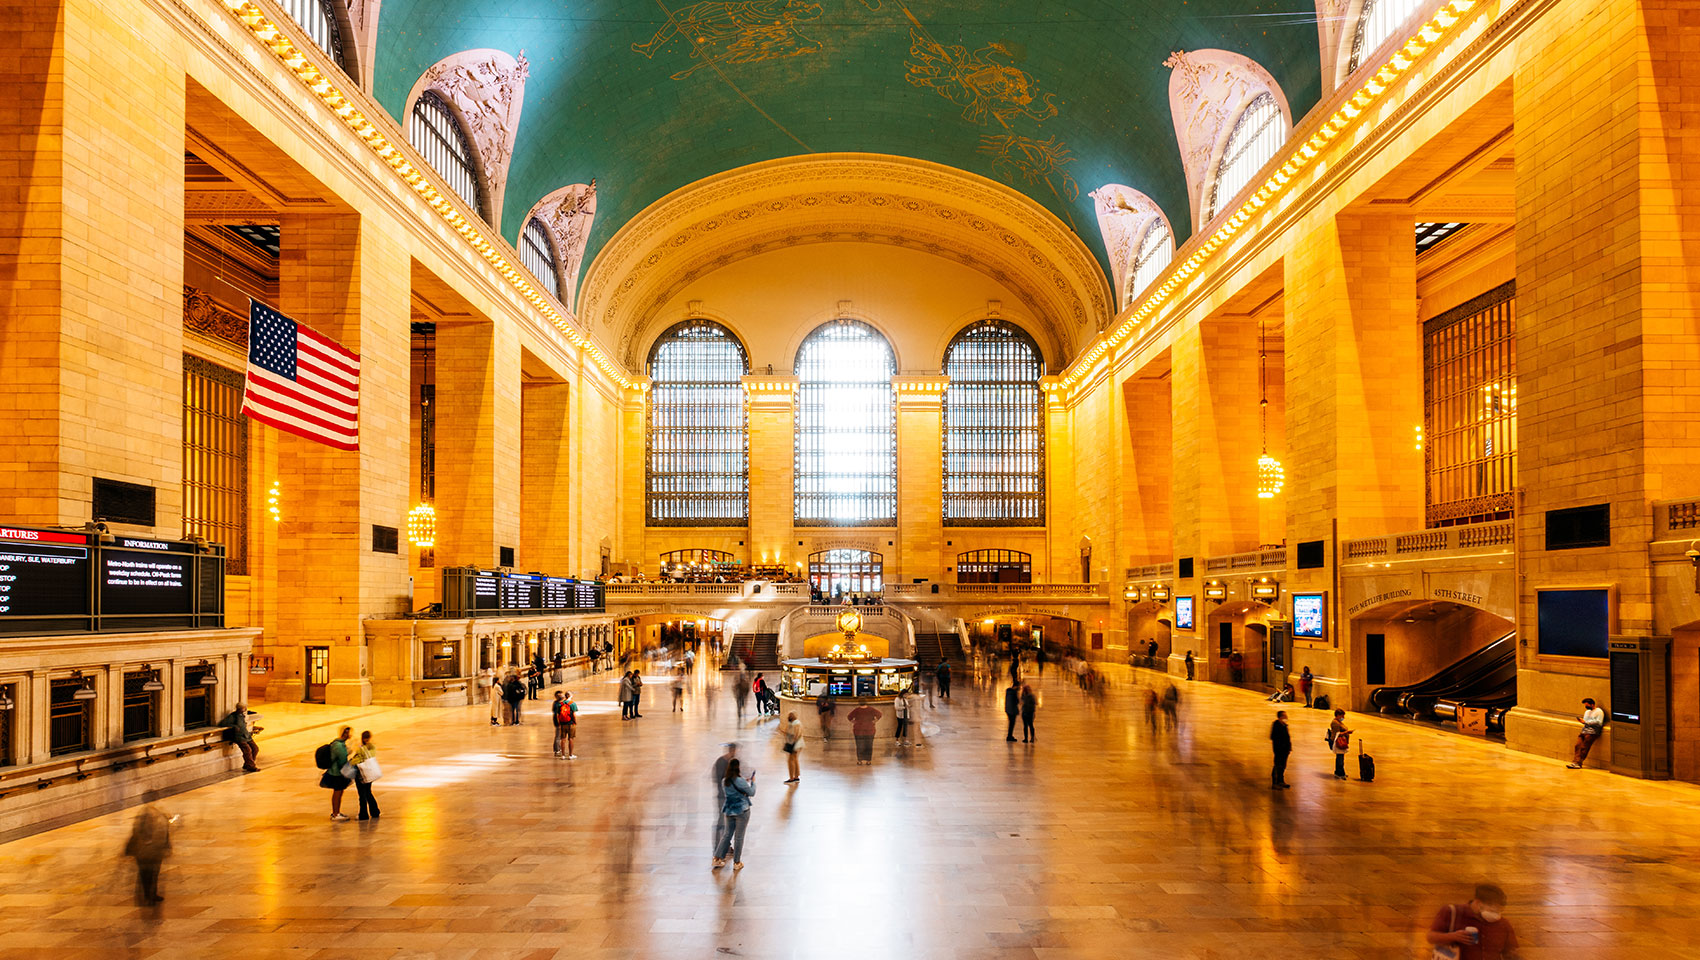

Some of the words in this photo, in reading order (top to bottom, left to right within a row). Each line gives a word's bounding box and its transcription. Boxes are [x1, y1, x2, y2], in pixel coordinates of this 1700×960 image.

[0, 529, 39, 540] RTURES
[124, 540, 168, 550] INFORMATION
[0, 555, 27, 563] ANBURY,
[41, 557, 76, 565] WATERBURY
[1348, 604, 1359, 615] THE
[1383, 589, 1412, 600] BUILDING
[1434, 589, 1452, 599] 45TH
[1453, 592, 1483, 604] STREET
